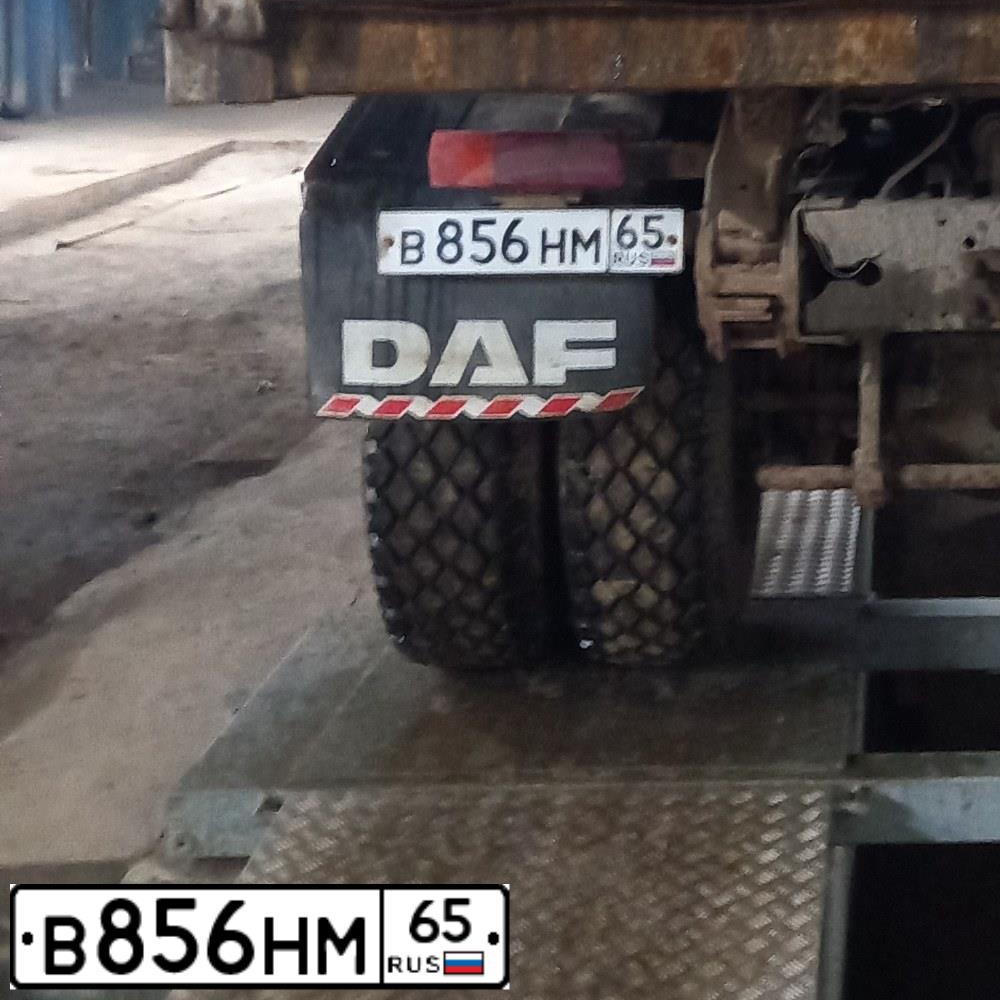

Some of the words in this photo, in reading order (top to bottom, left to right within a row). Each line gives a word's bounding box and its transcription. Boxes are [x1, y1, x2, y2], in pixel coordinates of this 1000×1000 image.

[616, 214, 665, 250] 65
[613, 251, 651, 268] RUS
[342, 319, 617, 387] DAF
